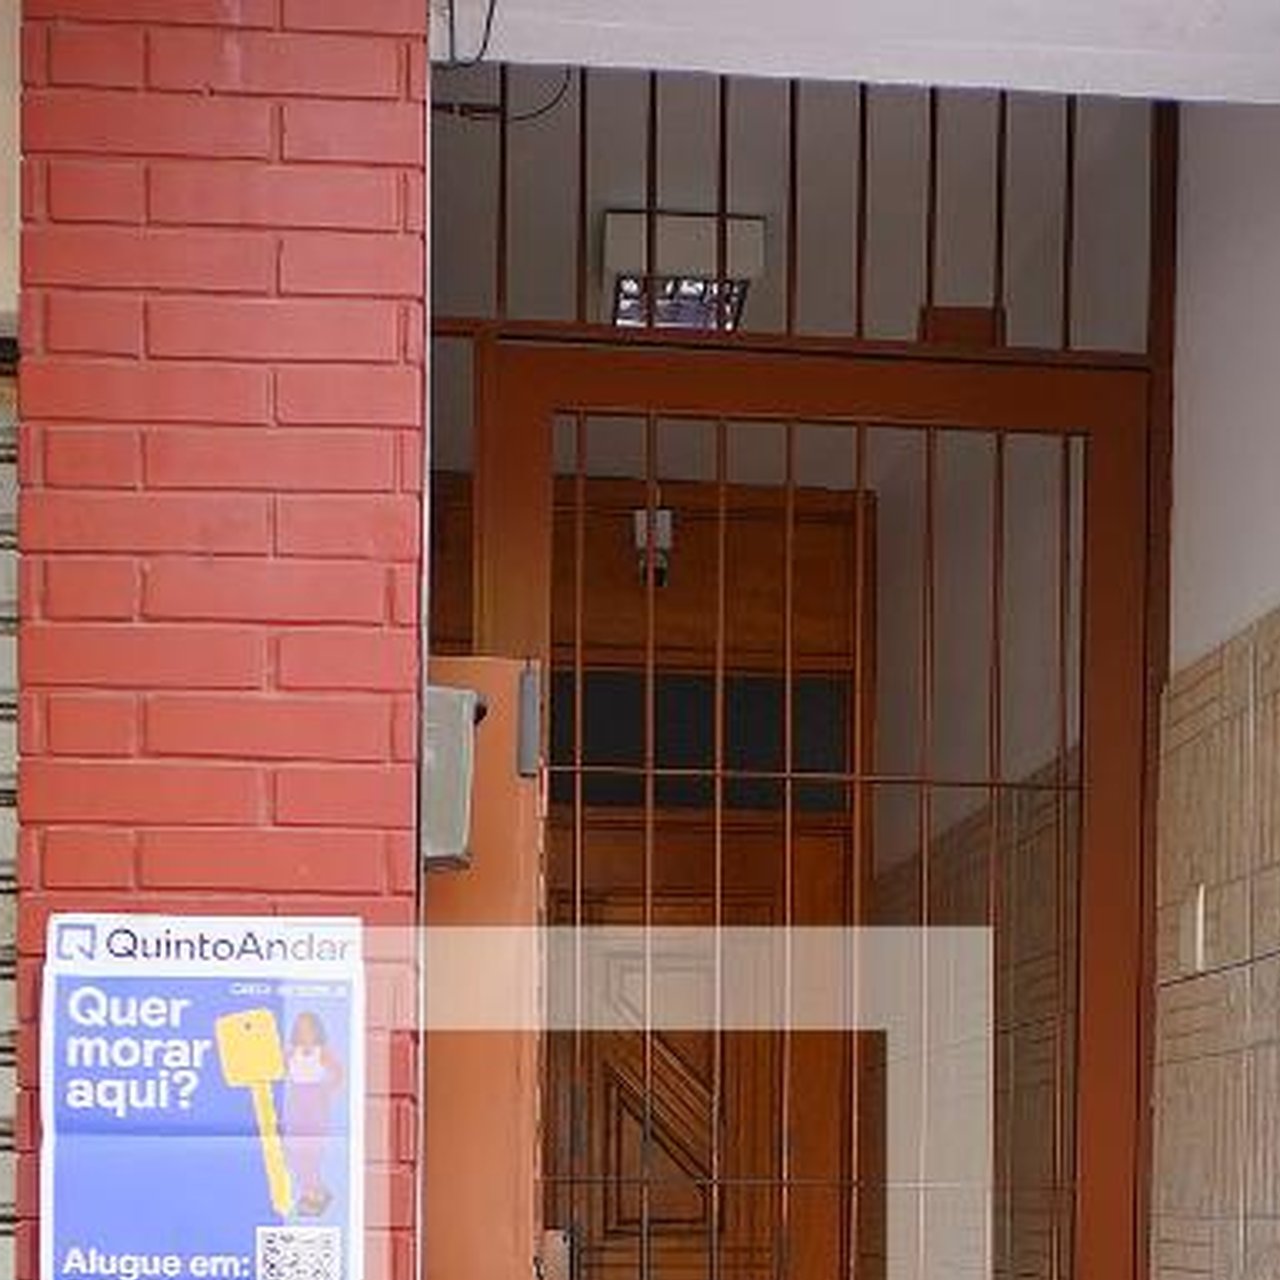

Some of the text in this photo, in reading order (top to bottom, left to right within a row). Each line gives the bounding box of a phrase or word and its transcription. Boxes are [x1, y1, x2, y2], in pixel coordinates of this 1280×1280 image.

[107, 928, 350, 961] QuintoAndar
[70, 986, 192, 1028] Quer
[67, 1036, 211, 1068] morar
[66, 1070, 199, 1118] aqui?
[62, 1248, 251, 1280] Alugue em:
